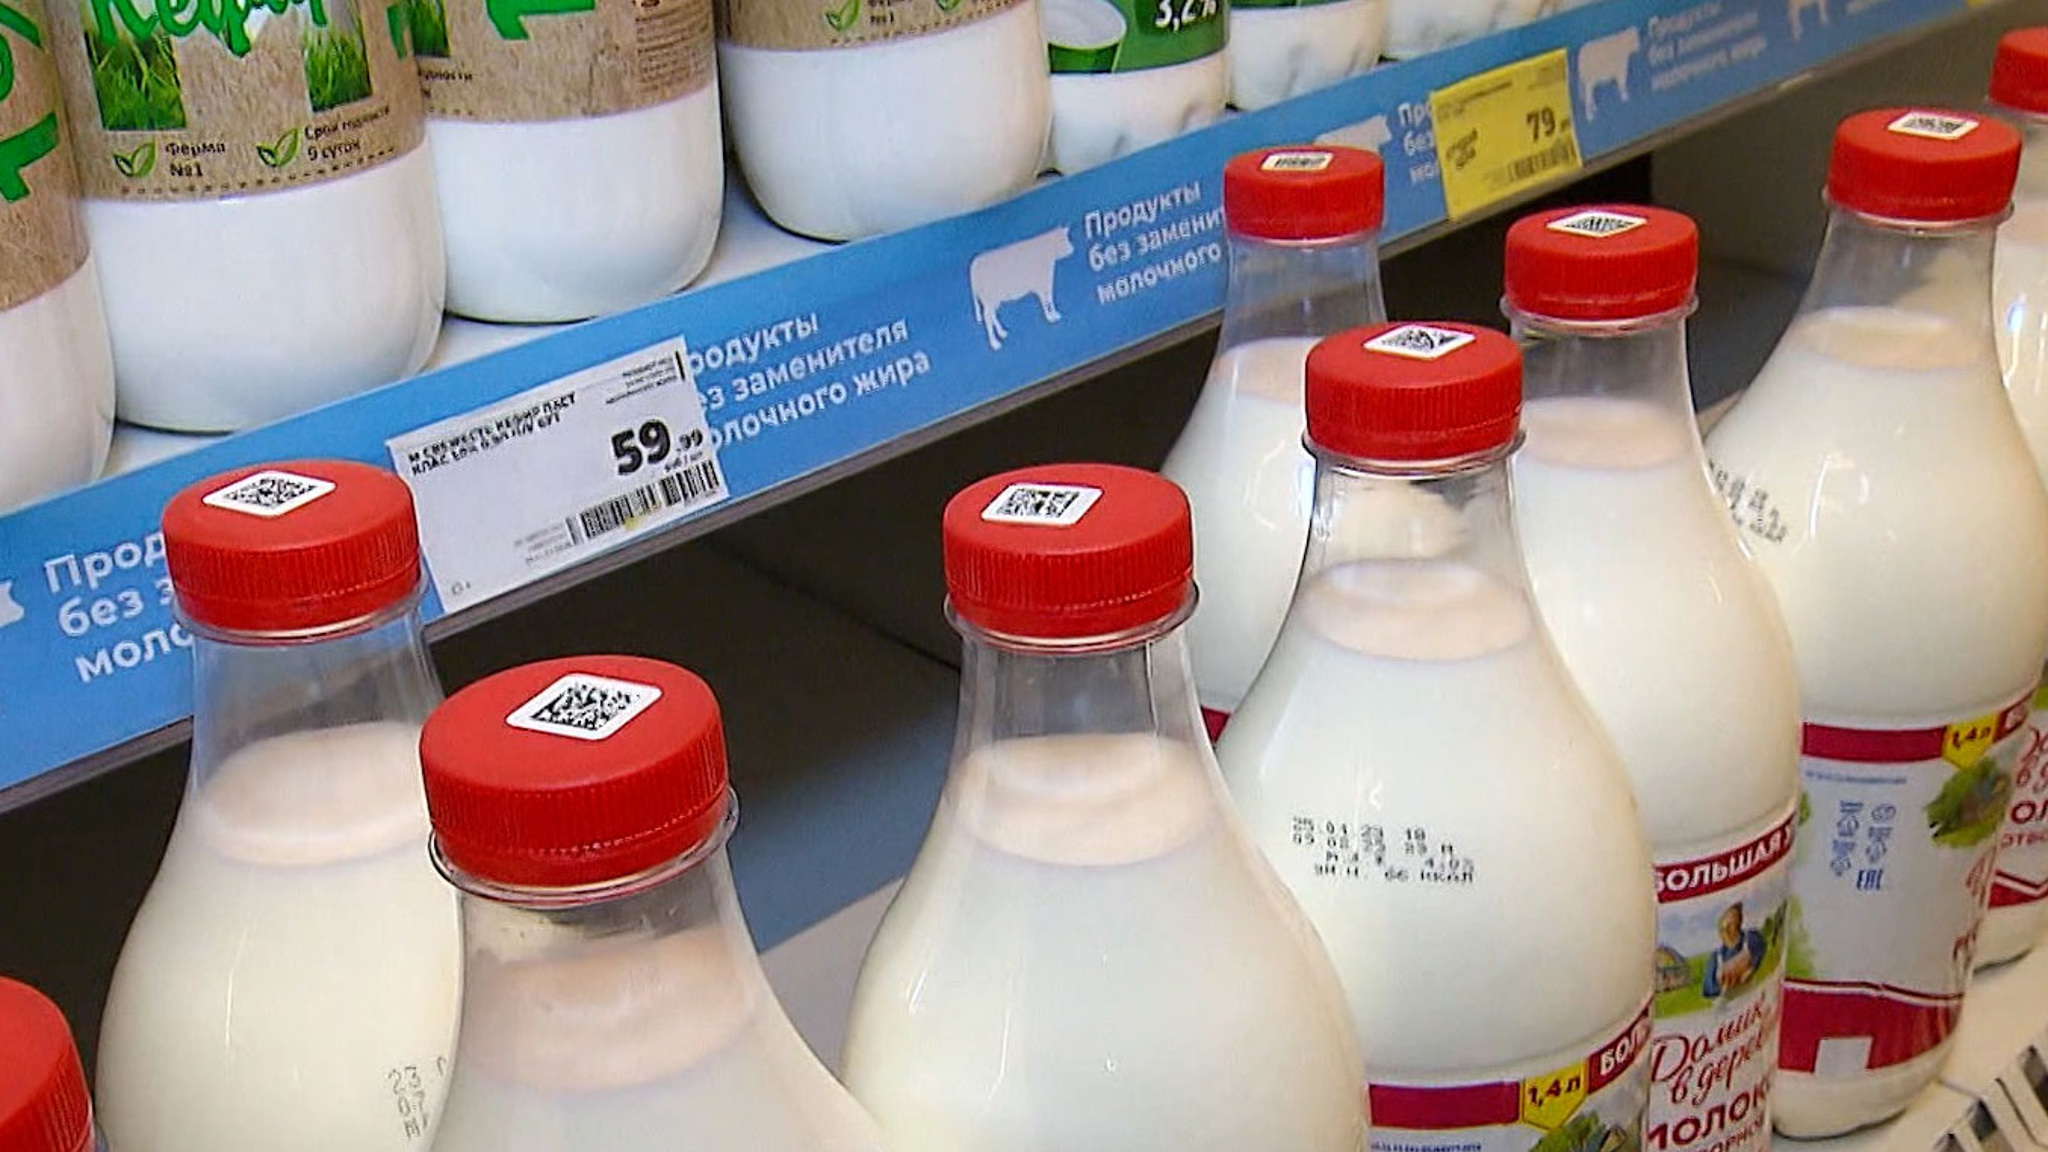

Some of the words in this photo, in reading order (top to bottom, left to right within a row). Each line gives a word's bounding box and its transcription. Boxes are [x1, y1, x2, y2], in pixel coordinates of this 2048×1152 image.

[1526, 107, 1556, 143] 79
[1084, 181, 1201, 239] Продукты
[1088, 241, 1131, 272] без
[1097, 242, 1222, 304] молочного
[731, 318, 909, 401] заменителя
[853, 349, 931, 397] жира
[611, 418, 671, 475] 59
[58, 587, 144, 638] без
